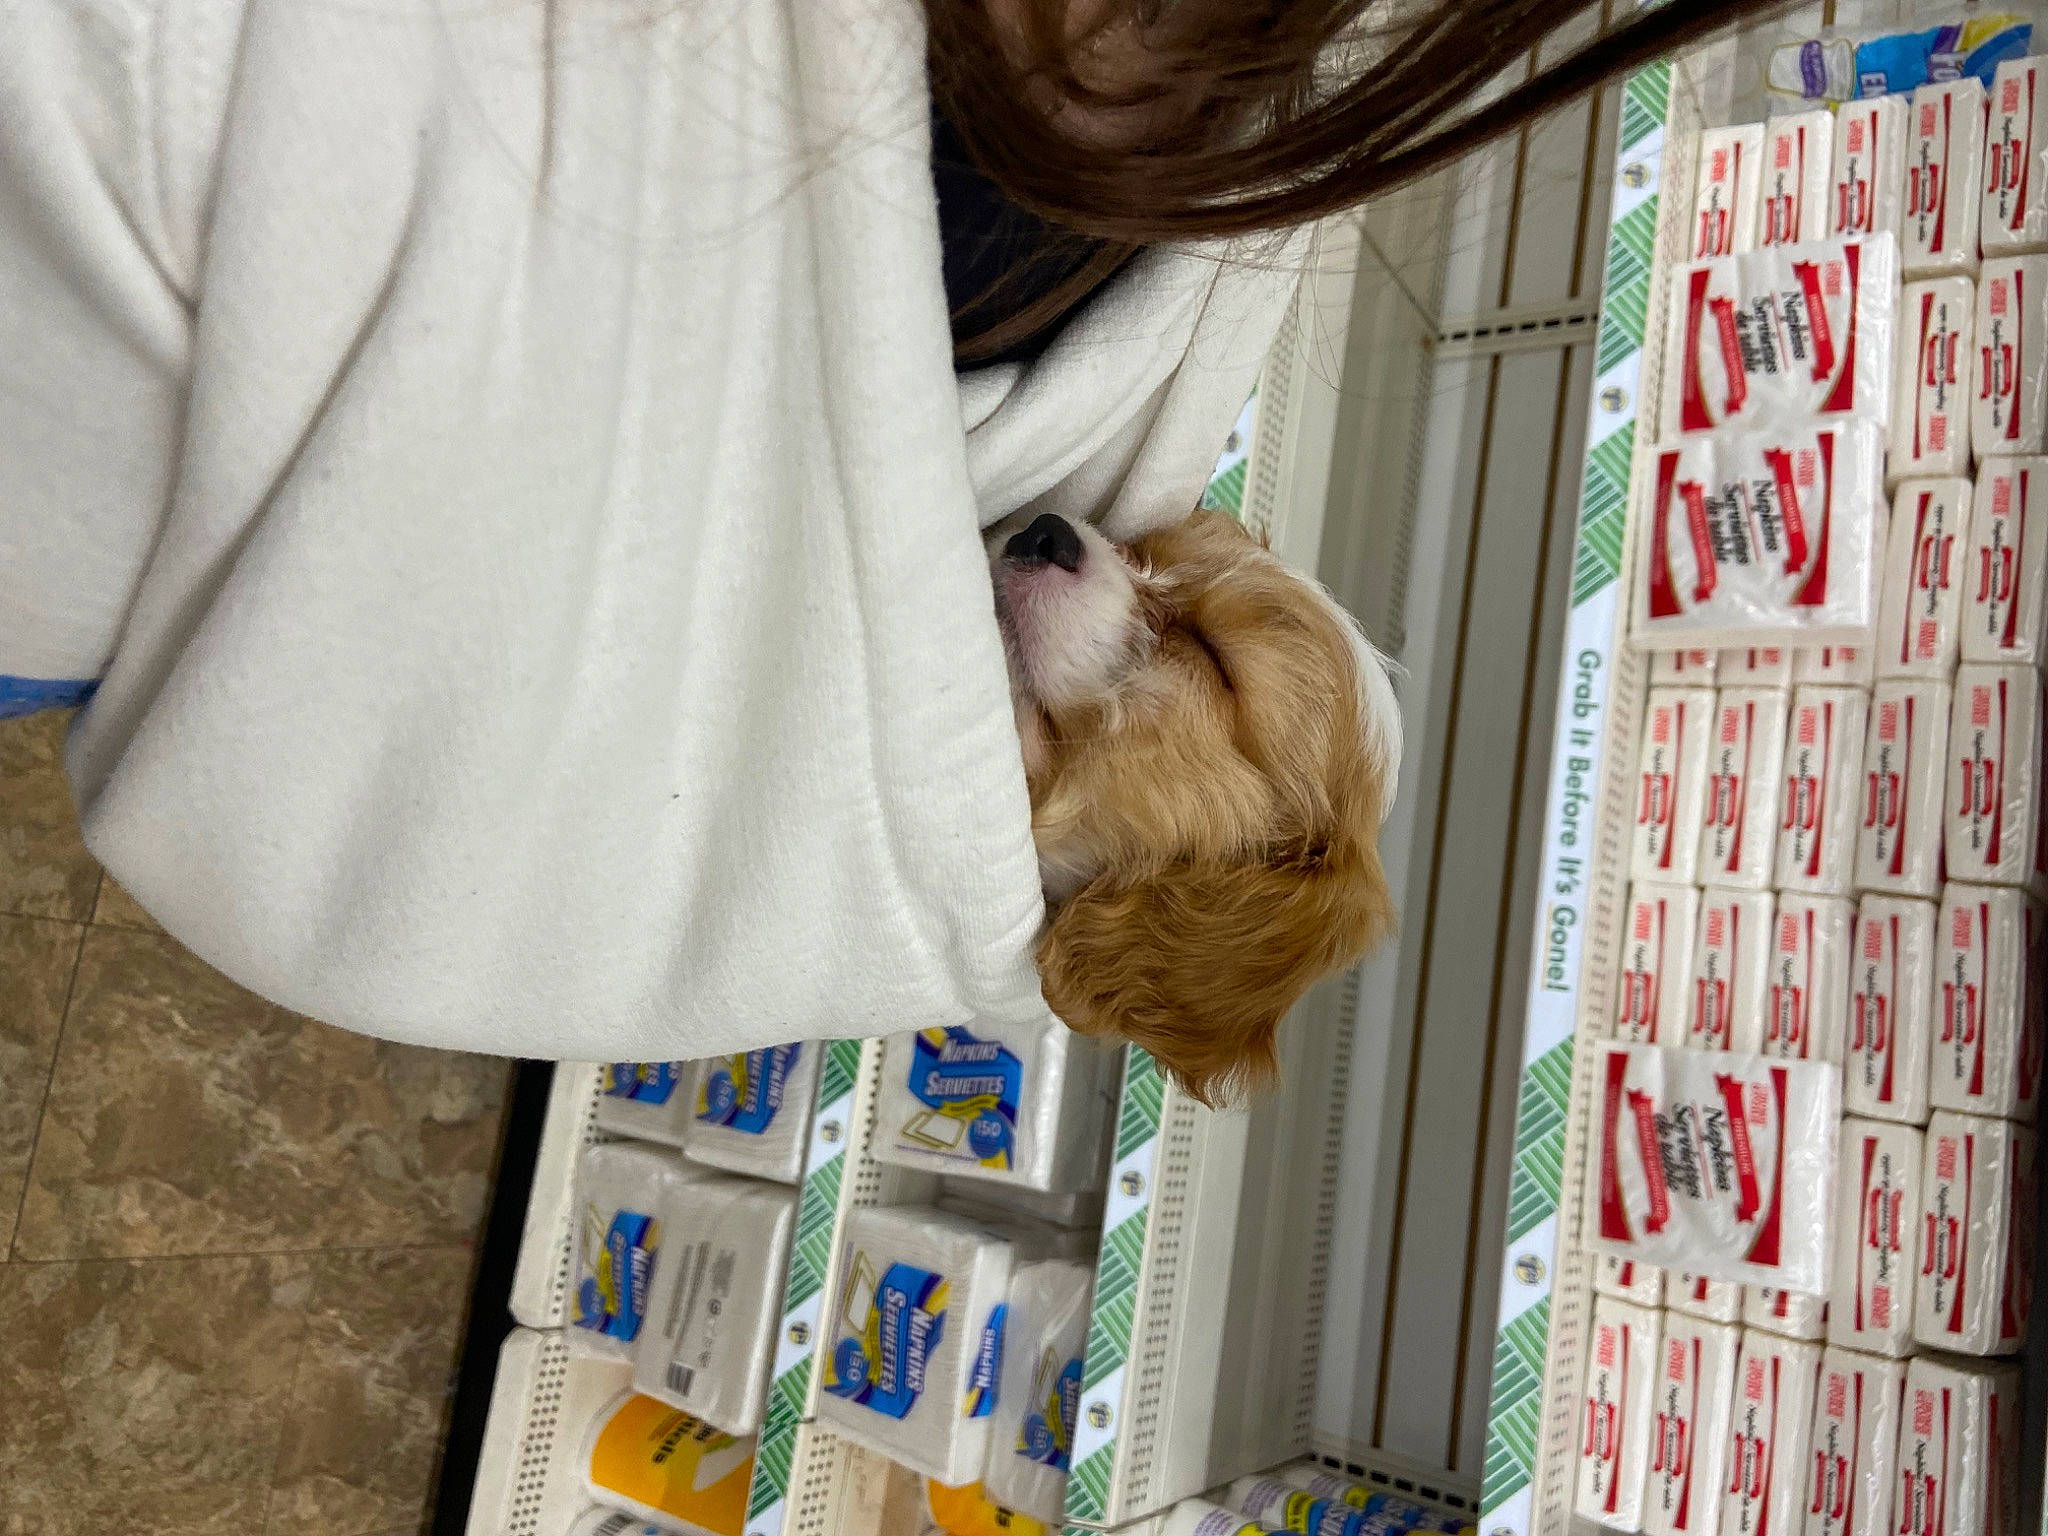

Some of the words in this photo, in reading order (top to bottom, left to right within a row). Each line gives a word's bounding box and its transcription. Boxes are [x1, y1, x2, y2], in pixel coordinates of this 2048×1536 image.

[1751, 296, 1779, 375] Serviettes
[1780, 292, 1809, 361] Napkins
[1722, 483, 1750, 566] Serviettes
[1751, 480, 1782, 553] Napkins
[1572, 649, 1603, 718] Grab
[1570, 729, 1595, 748] It
[1559, 756, 1590, 847] Before
[1555, 857, 1585, 894] It's
[1546, 905, 1578, 992] Gone!
[926, 1071, 1006, 1096] SERVIETTES
[939, 1040, 1000, 1062] NAPKINS
[974, 1120, 1002, 1138] 150
[1672, 1104, 1702, 1200] Serviettes
[1700, 1106, 1734, 1193] Napkins
[630, 1245, 650, 1316] NAPKINS
[846, 1350, 864, 1382] 150
[881, 1286, 908, 1395] SERVIETTES
[905, 1306, 935, 1395] NAPKINS
[976, 1327, 997, 1388] NAPKINS
